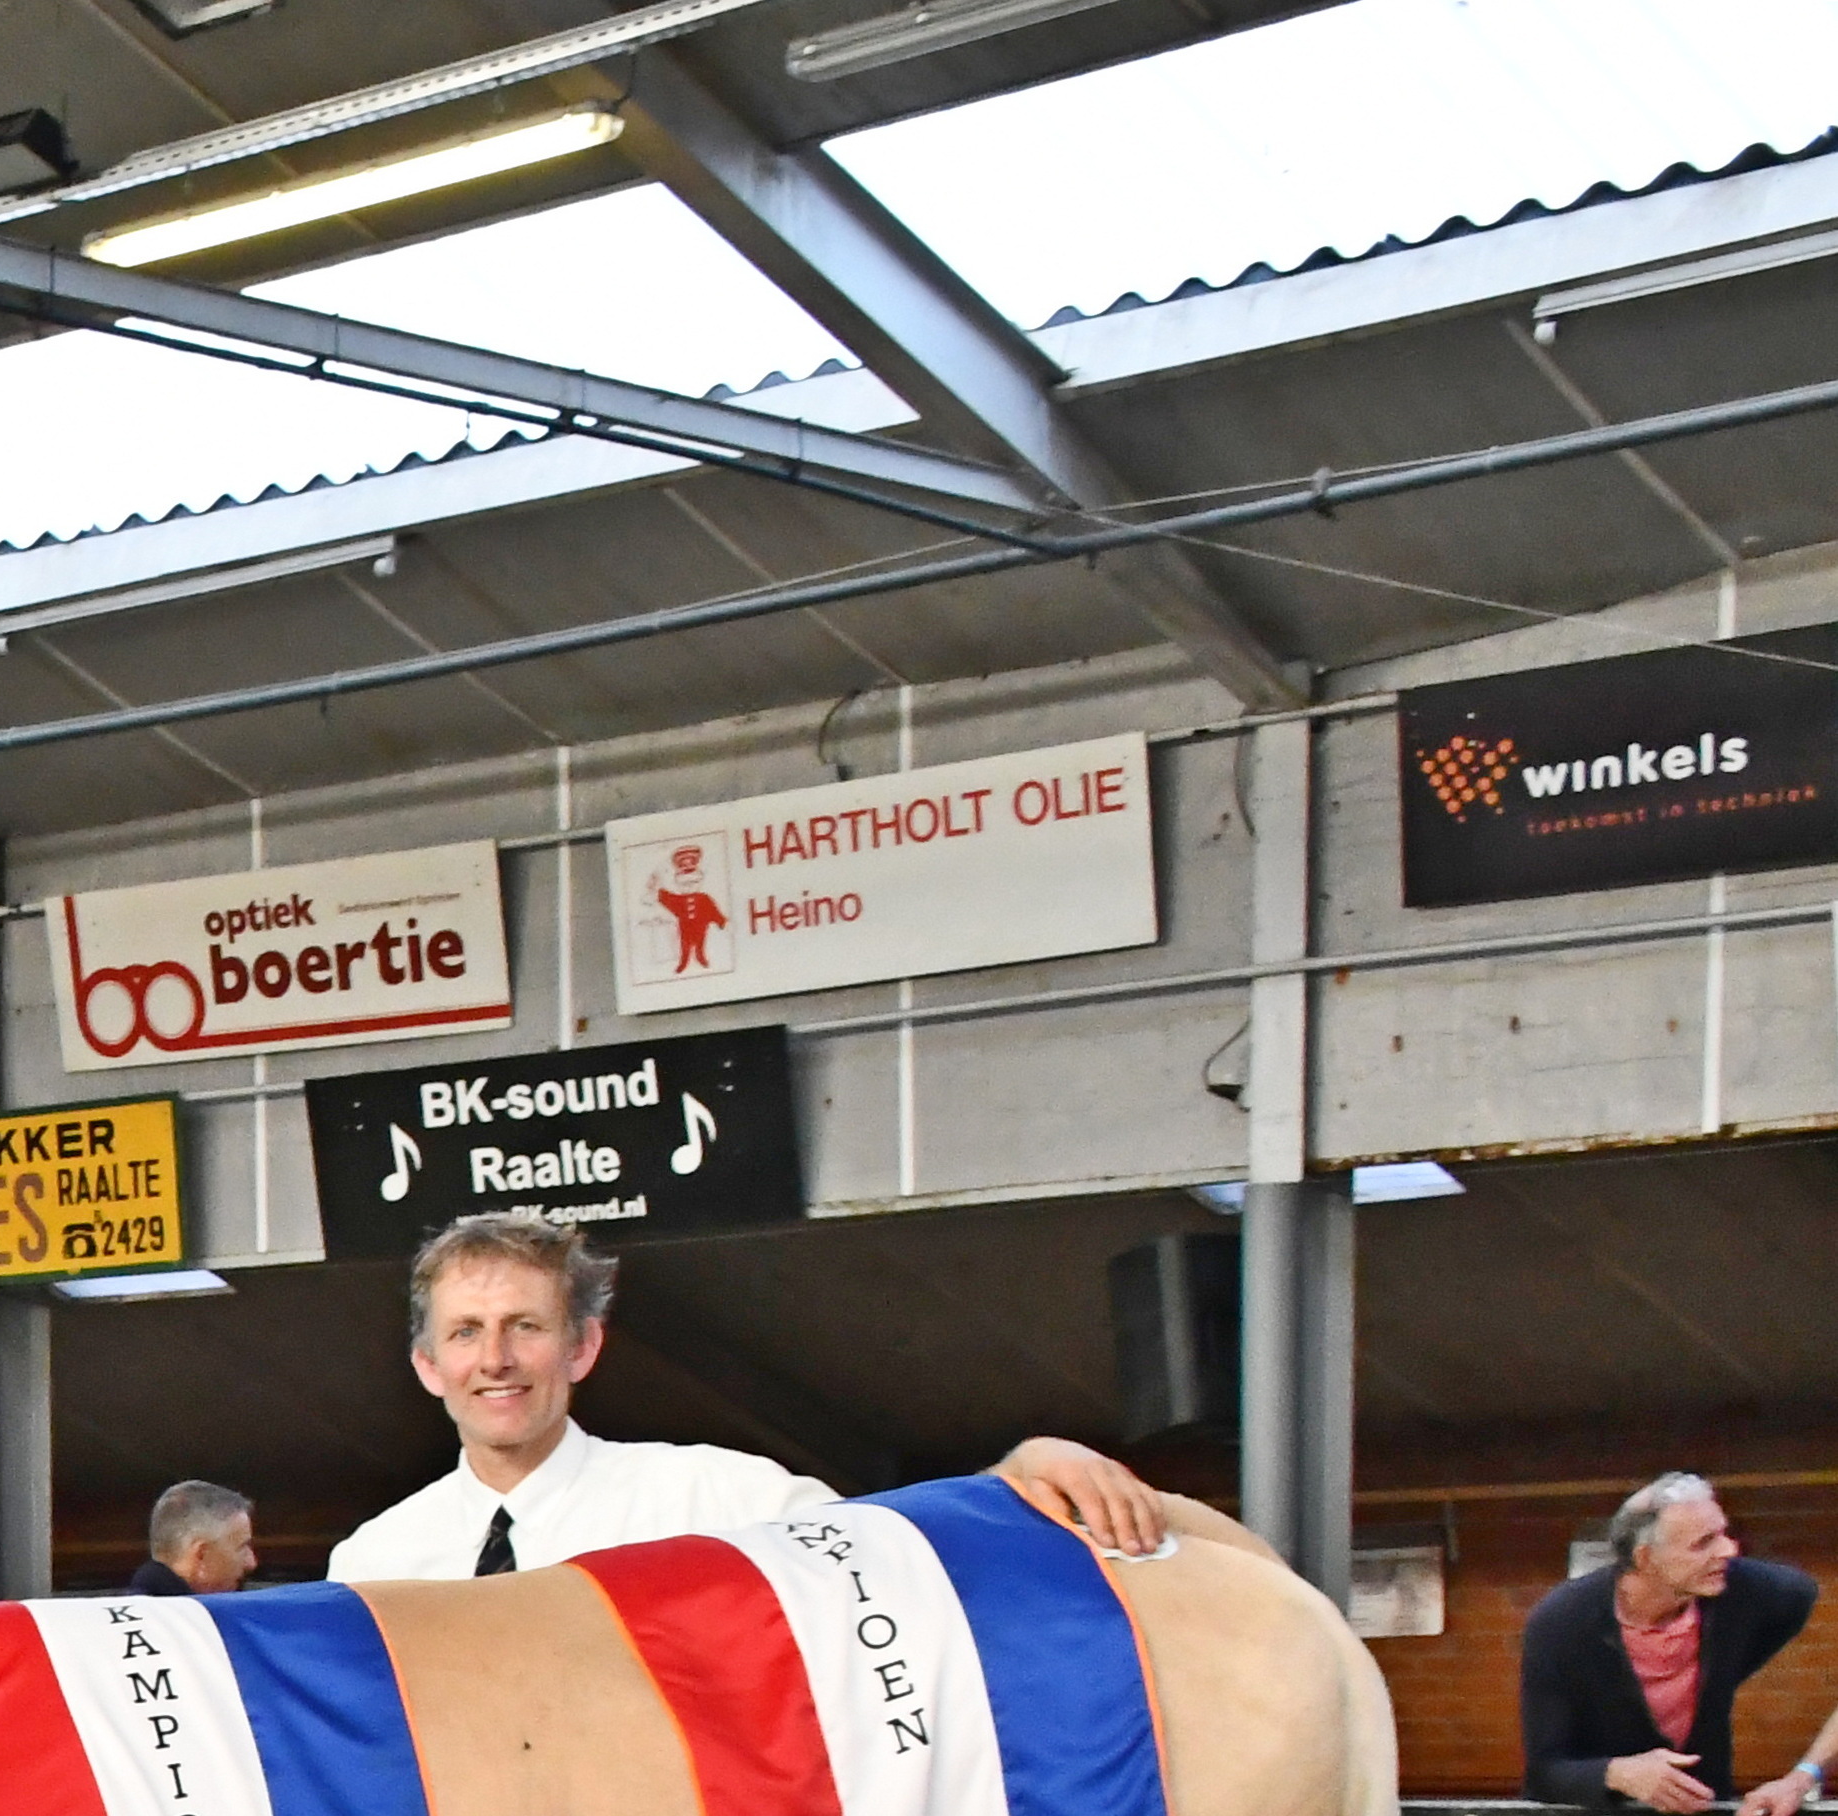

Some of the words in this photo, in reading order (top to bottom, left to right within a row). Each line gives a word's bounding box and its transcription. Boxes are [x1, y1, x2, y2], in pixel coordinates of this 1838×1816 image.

[1522, 731, 1749, 798] winkels
[743, 789, 992, 869] HARTHOLT
[1013, 766, 1127, 827] OLIE
[204, 893, 316, 943] optiek
[748, 890, 863, 935] Heino
[209, 917, 467, 1005] boertie
[420, 1057, 660, 1129] BK-sound
[57, 1158, 161, 1206] RAALTE
[470, 1138, 621, 1194] Raalte
[102, 1216, 165, 1257] 2429
[787, 1522, 931, 1755] MPIOEN
